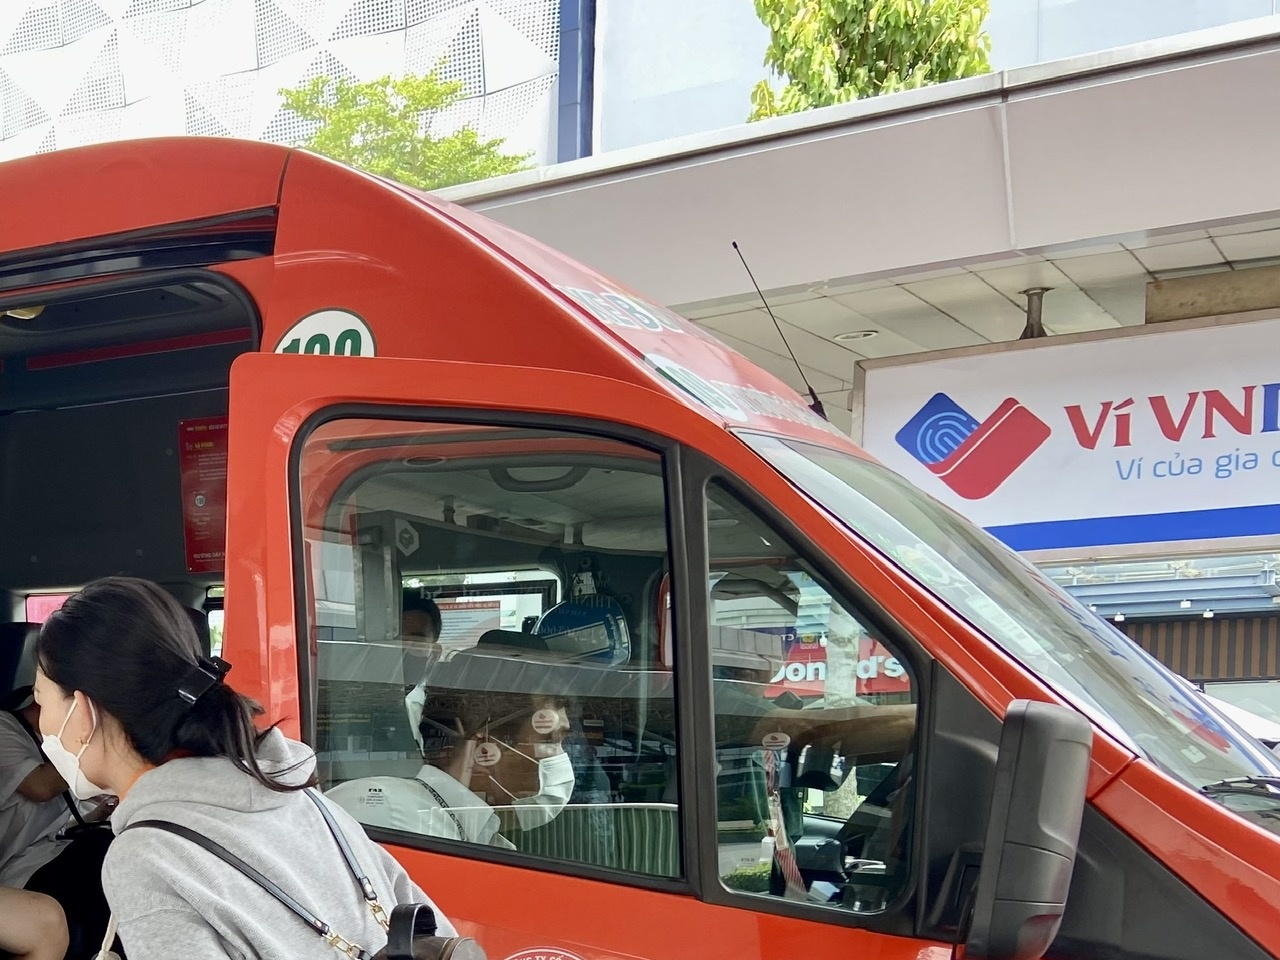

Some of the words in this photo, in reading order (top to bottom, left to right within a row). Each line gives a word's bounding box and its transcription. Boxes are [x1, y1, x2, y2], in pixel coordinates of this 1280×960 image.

[1063, 397, 1135, 450] Ví
[1115, 457, 1144, 480] Ví
[1152, 452, 1203, 478] của
[1214, 448, 1259, 479] gia
